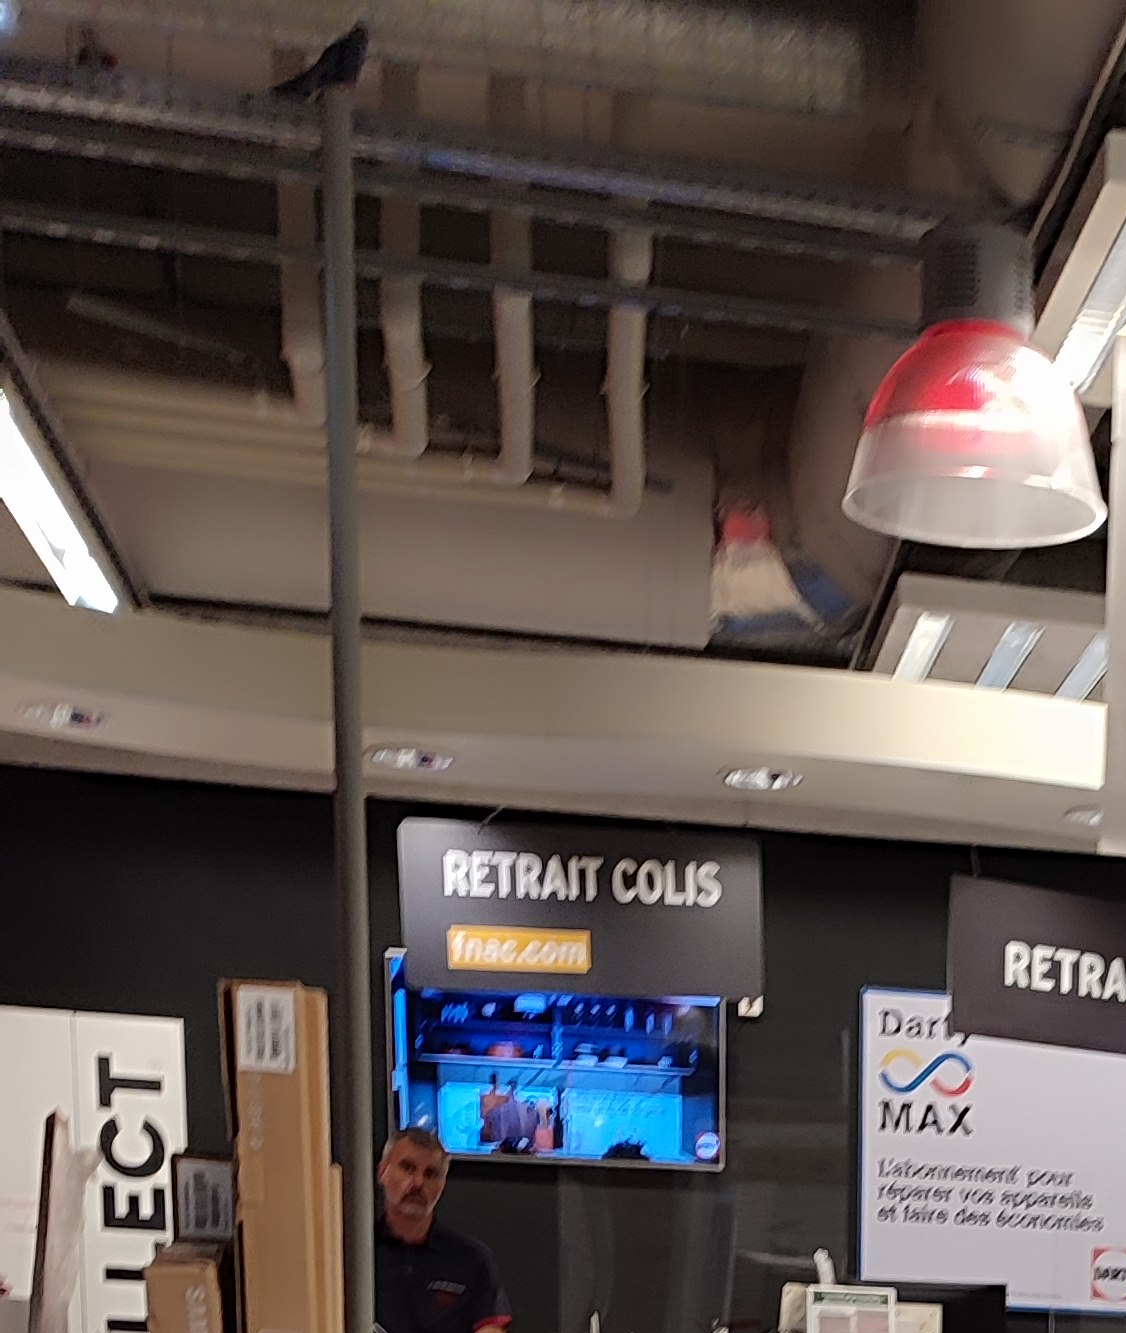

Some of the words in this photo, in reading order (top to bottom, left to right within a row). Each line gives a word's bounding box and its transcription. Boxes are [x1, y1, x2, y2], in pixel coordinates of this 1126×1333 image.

[443, 849, 604, 902] RETRAIT
[612, 858, 722, 908] COLIS
[452, 931, 587, 966] fnac.com
[879, 1009, 971, 1047] Dart
[878, 1100, 973, 1137] MAX
[877, 1157, 1022, 1185] L'abonnement
[1026, 1169, 1075, 1188] pour
[877, 1179, 953, 1205] réparer
[1000, 1190, 1094, 1211] appareils
[903, 1205, 948, 1225] faire
[953, 1206, 990, 1227] des
[996, 1207, 1105, 1232] économies
